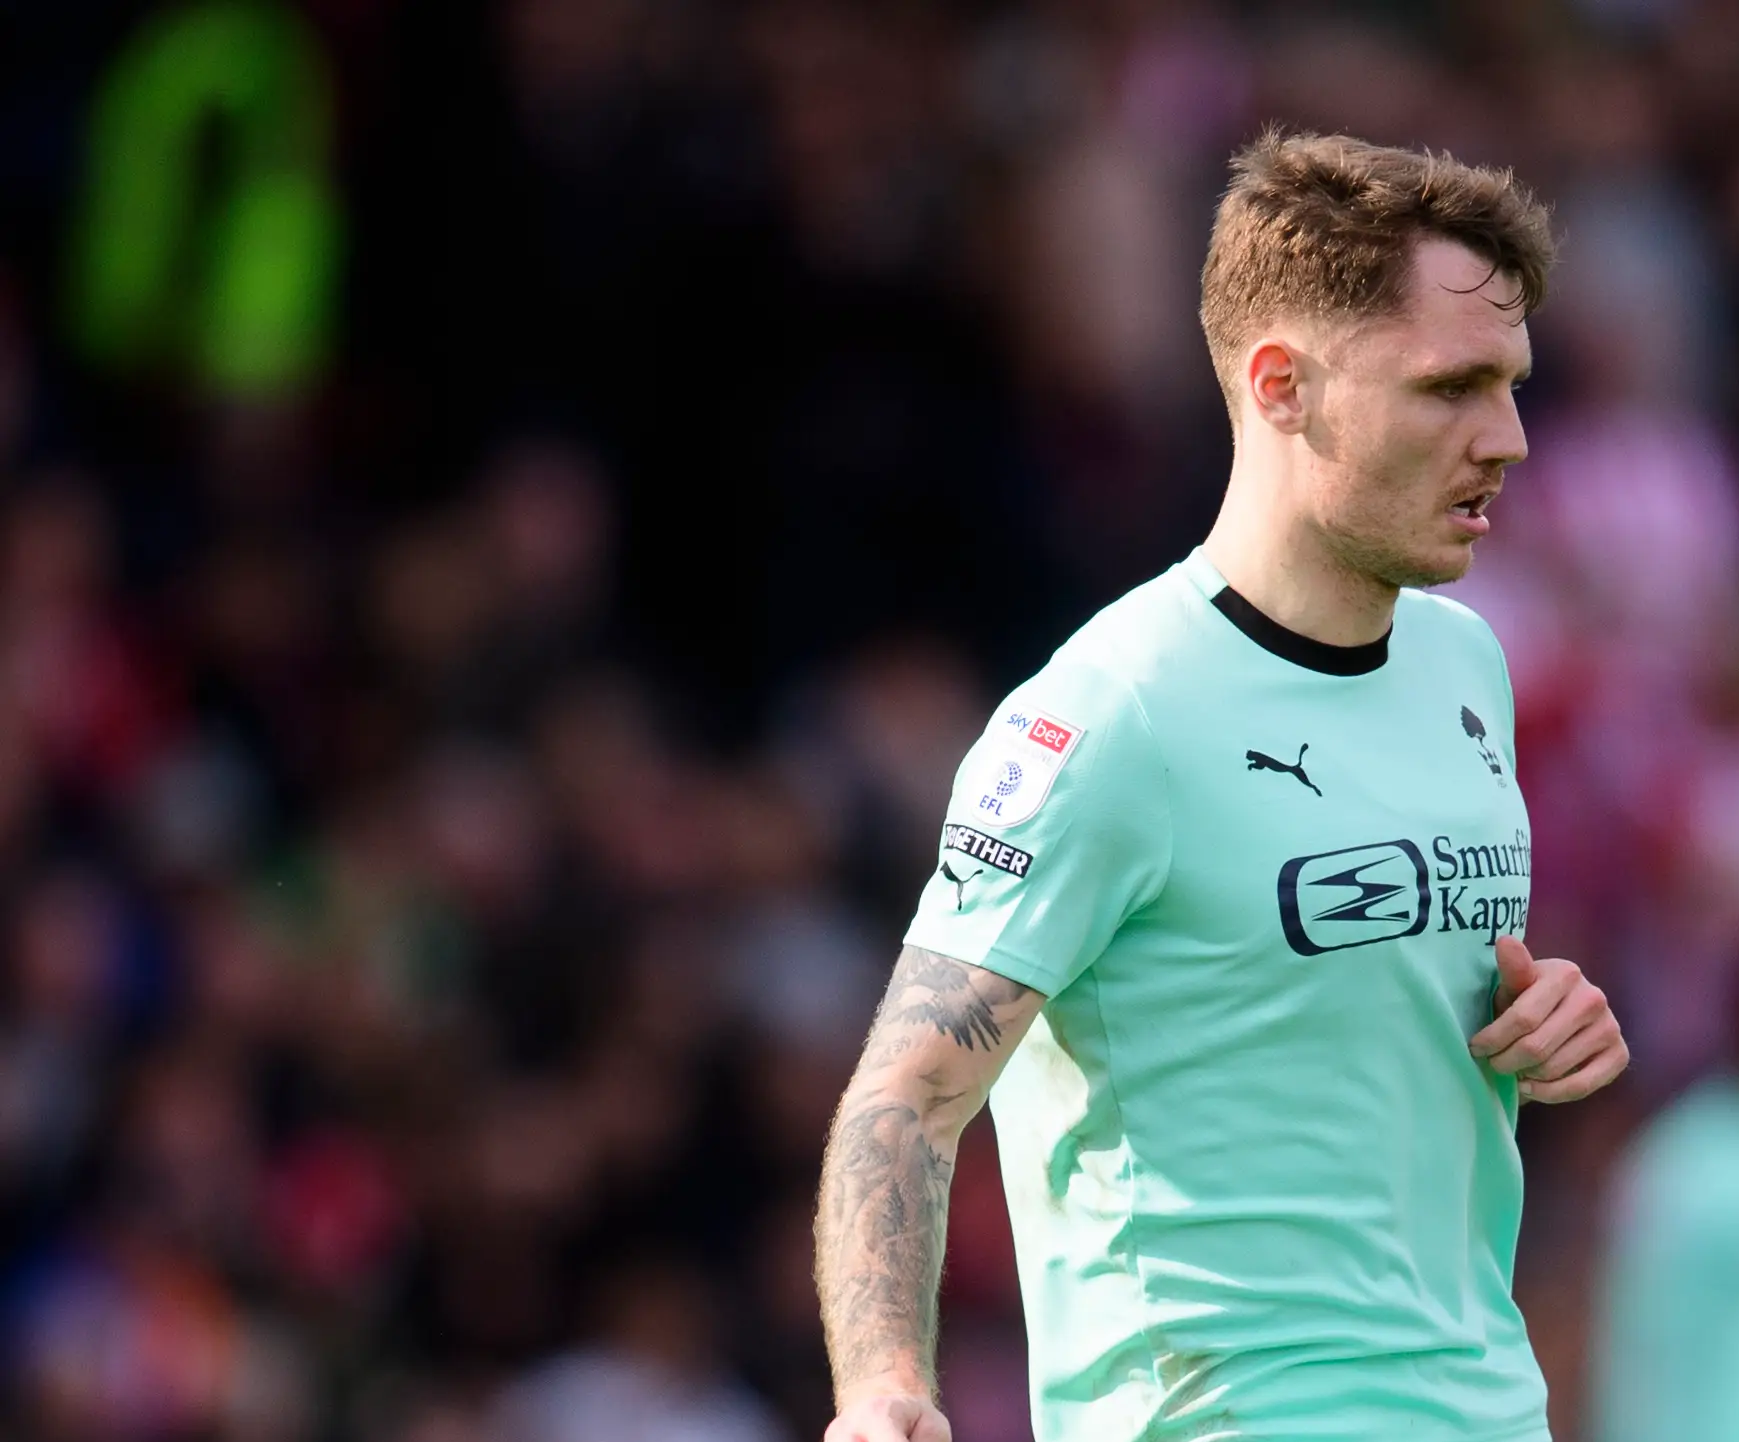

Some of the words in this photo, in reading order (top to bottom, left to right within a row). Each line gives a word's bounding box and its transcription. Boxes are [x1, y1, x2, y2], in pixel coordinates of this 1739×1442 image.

[1007, 712, 1033, 732] sky
[1032, 720, 1066, 749] bet
[979, 794, 1003, 817] EFL
[1432, 827, 1531, 882] Smurfi
